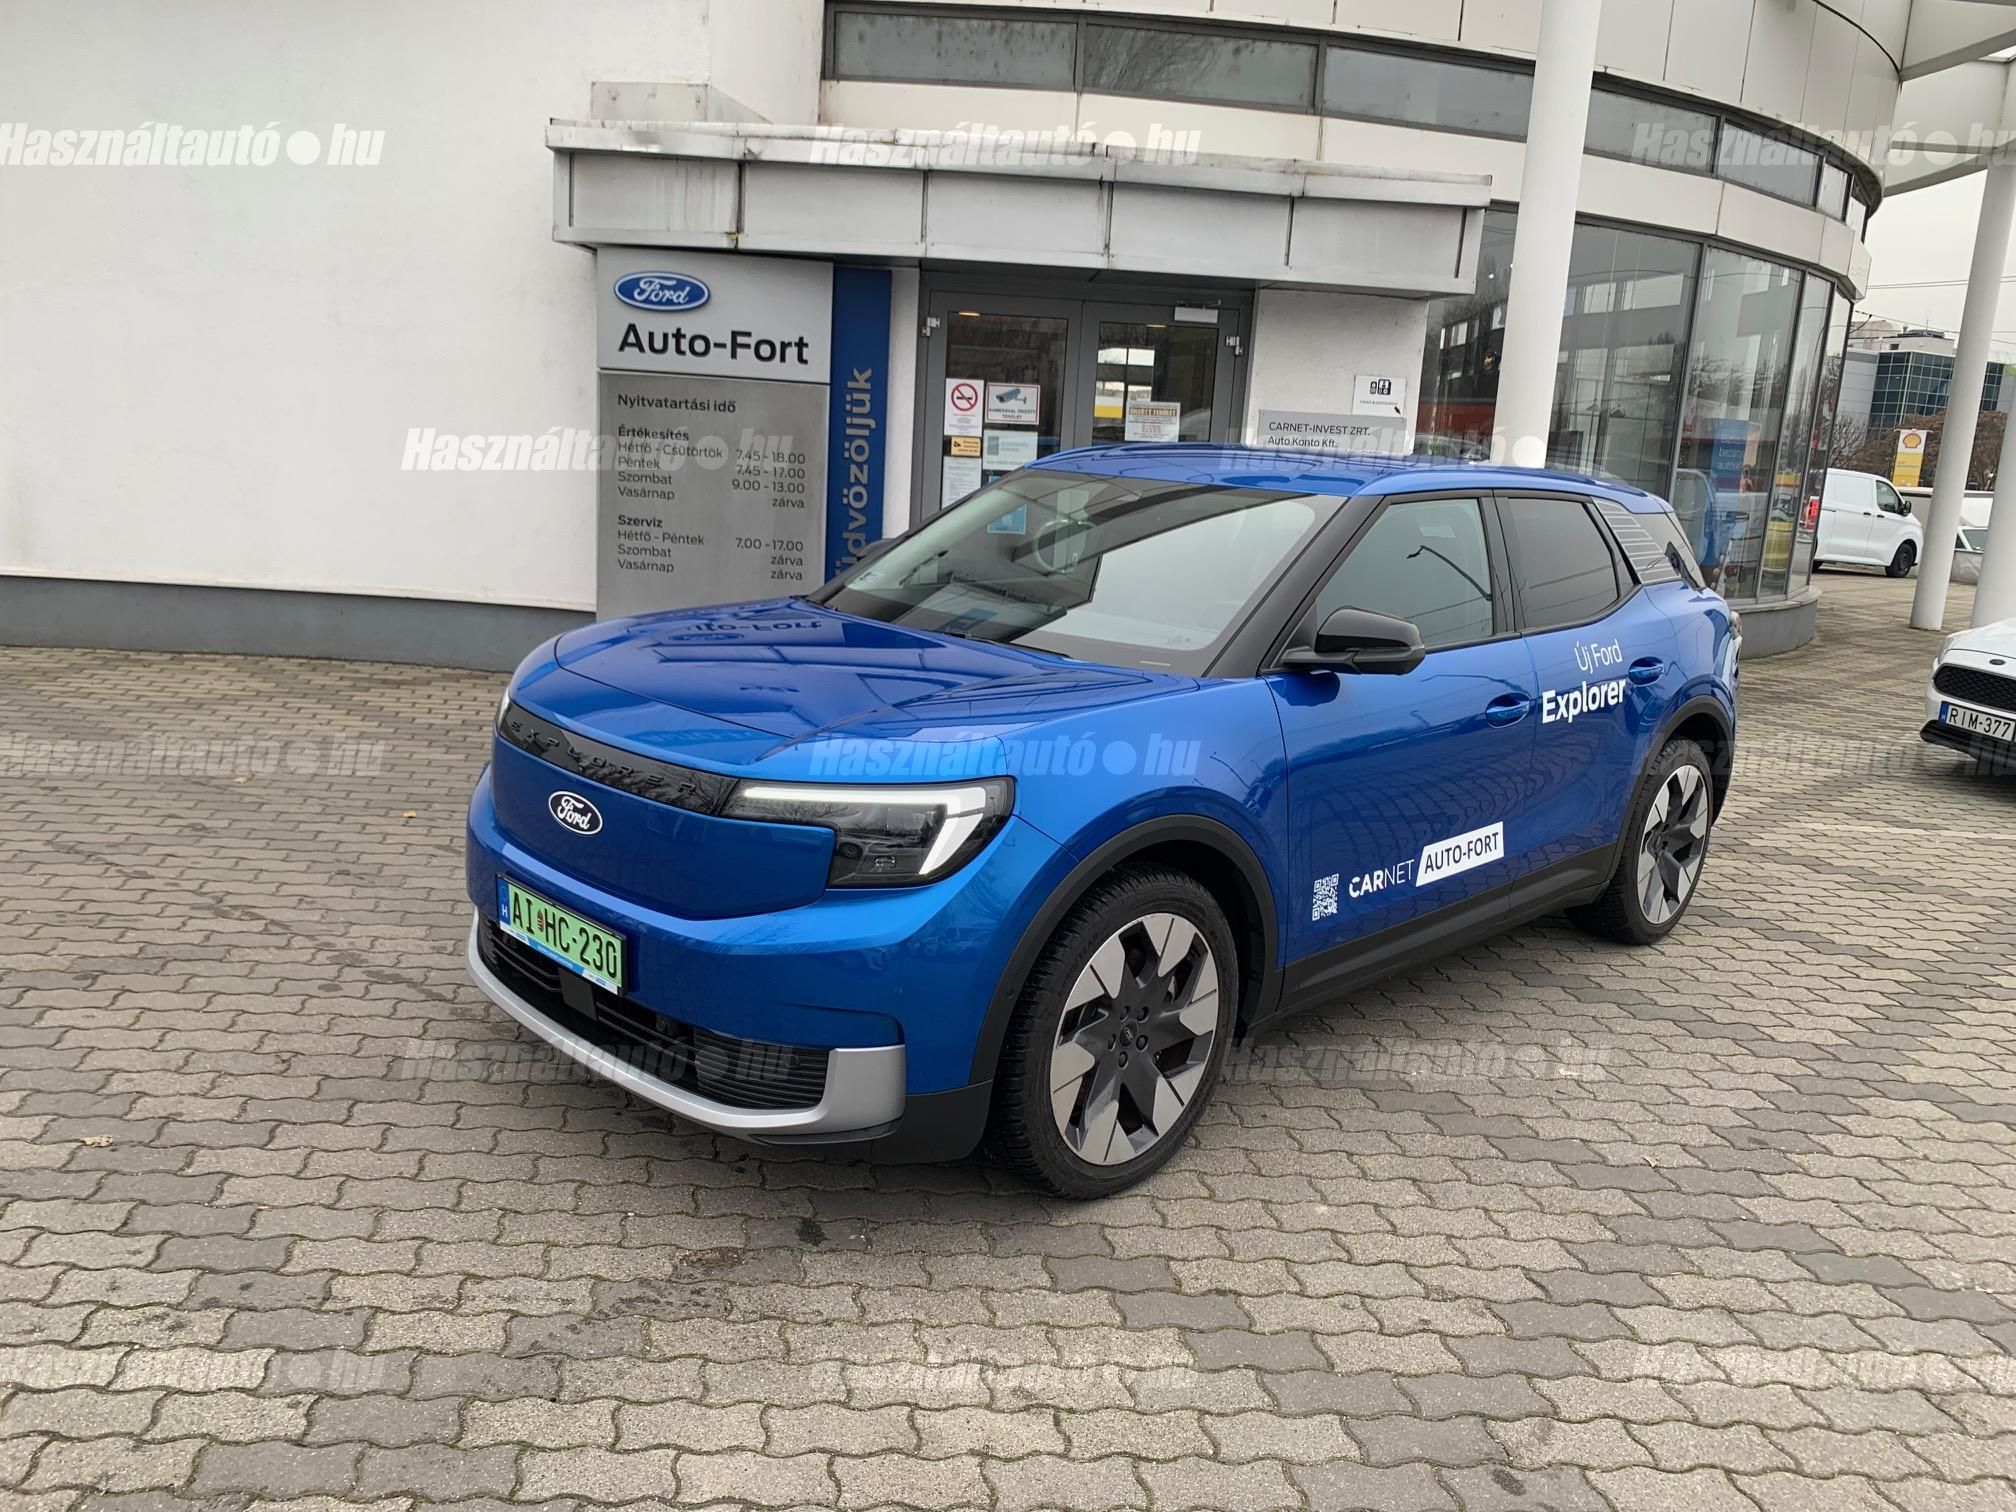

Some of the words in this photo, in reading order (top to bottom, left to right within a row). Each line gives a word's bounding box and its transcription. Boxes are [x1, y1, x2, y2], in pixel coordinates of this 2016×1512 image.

[633, 278, 690, 304] Ford
[618, 323, 809, 365] Auto-Fort
[617, 394, 710, 412] Nyitvatartási
[713, 400, 736, 413] idő
[618, 424, 690, 441] Értékesítés
[1268, 421, 1347, 435] CARNET-INVEST
[1349, 425, 1370, 436] ZRT.
[1267, 435, 1291, 446] Auto
[1292, 437, 1320, 448] Konto
[1321, 438, 1338, 448] Kft.
[618, 456, 661, 470] Péntek
[736, 449, 761, 462] 7.45
[772, 451, 806, 465] 18.00
[618, 471, 673, 485] Szombat
[736, 465, 761, 477] 7.45
[773, 467, 806, 480] 17.00
[618, 486, 675, 501] Vasárnap
[732, 479, 761, 492] 9.00
[772, 481, 805, 494] 13.00
[772, 497, 805, 509] zárva
[618, 514, 664, 528] Szerviz
[663, 532, 704, 546] Péntek
[735, 537, 762, 549] 7.00
[772, 539, 804, 552] 17.00
[618, 543, 672, 558] Szombat
[618, 559, 675, 574] Vasárnap
[770, 555, 803, 567] zárva
[770, 569, 803, 581] zárva
[1575, 640, 1594, 675] Új
[1595, 638, 1623, 666] Ford
[1542, 679, 1627, 725] Explorer
[1949, 708, 2011, 738] RIM-377
[556, 796, 591, 830] Ford
[1424, 831, 1499, 875] AUTO-FORT
[1348, 859, 1415, 899] CARNET
